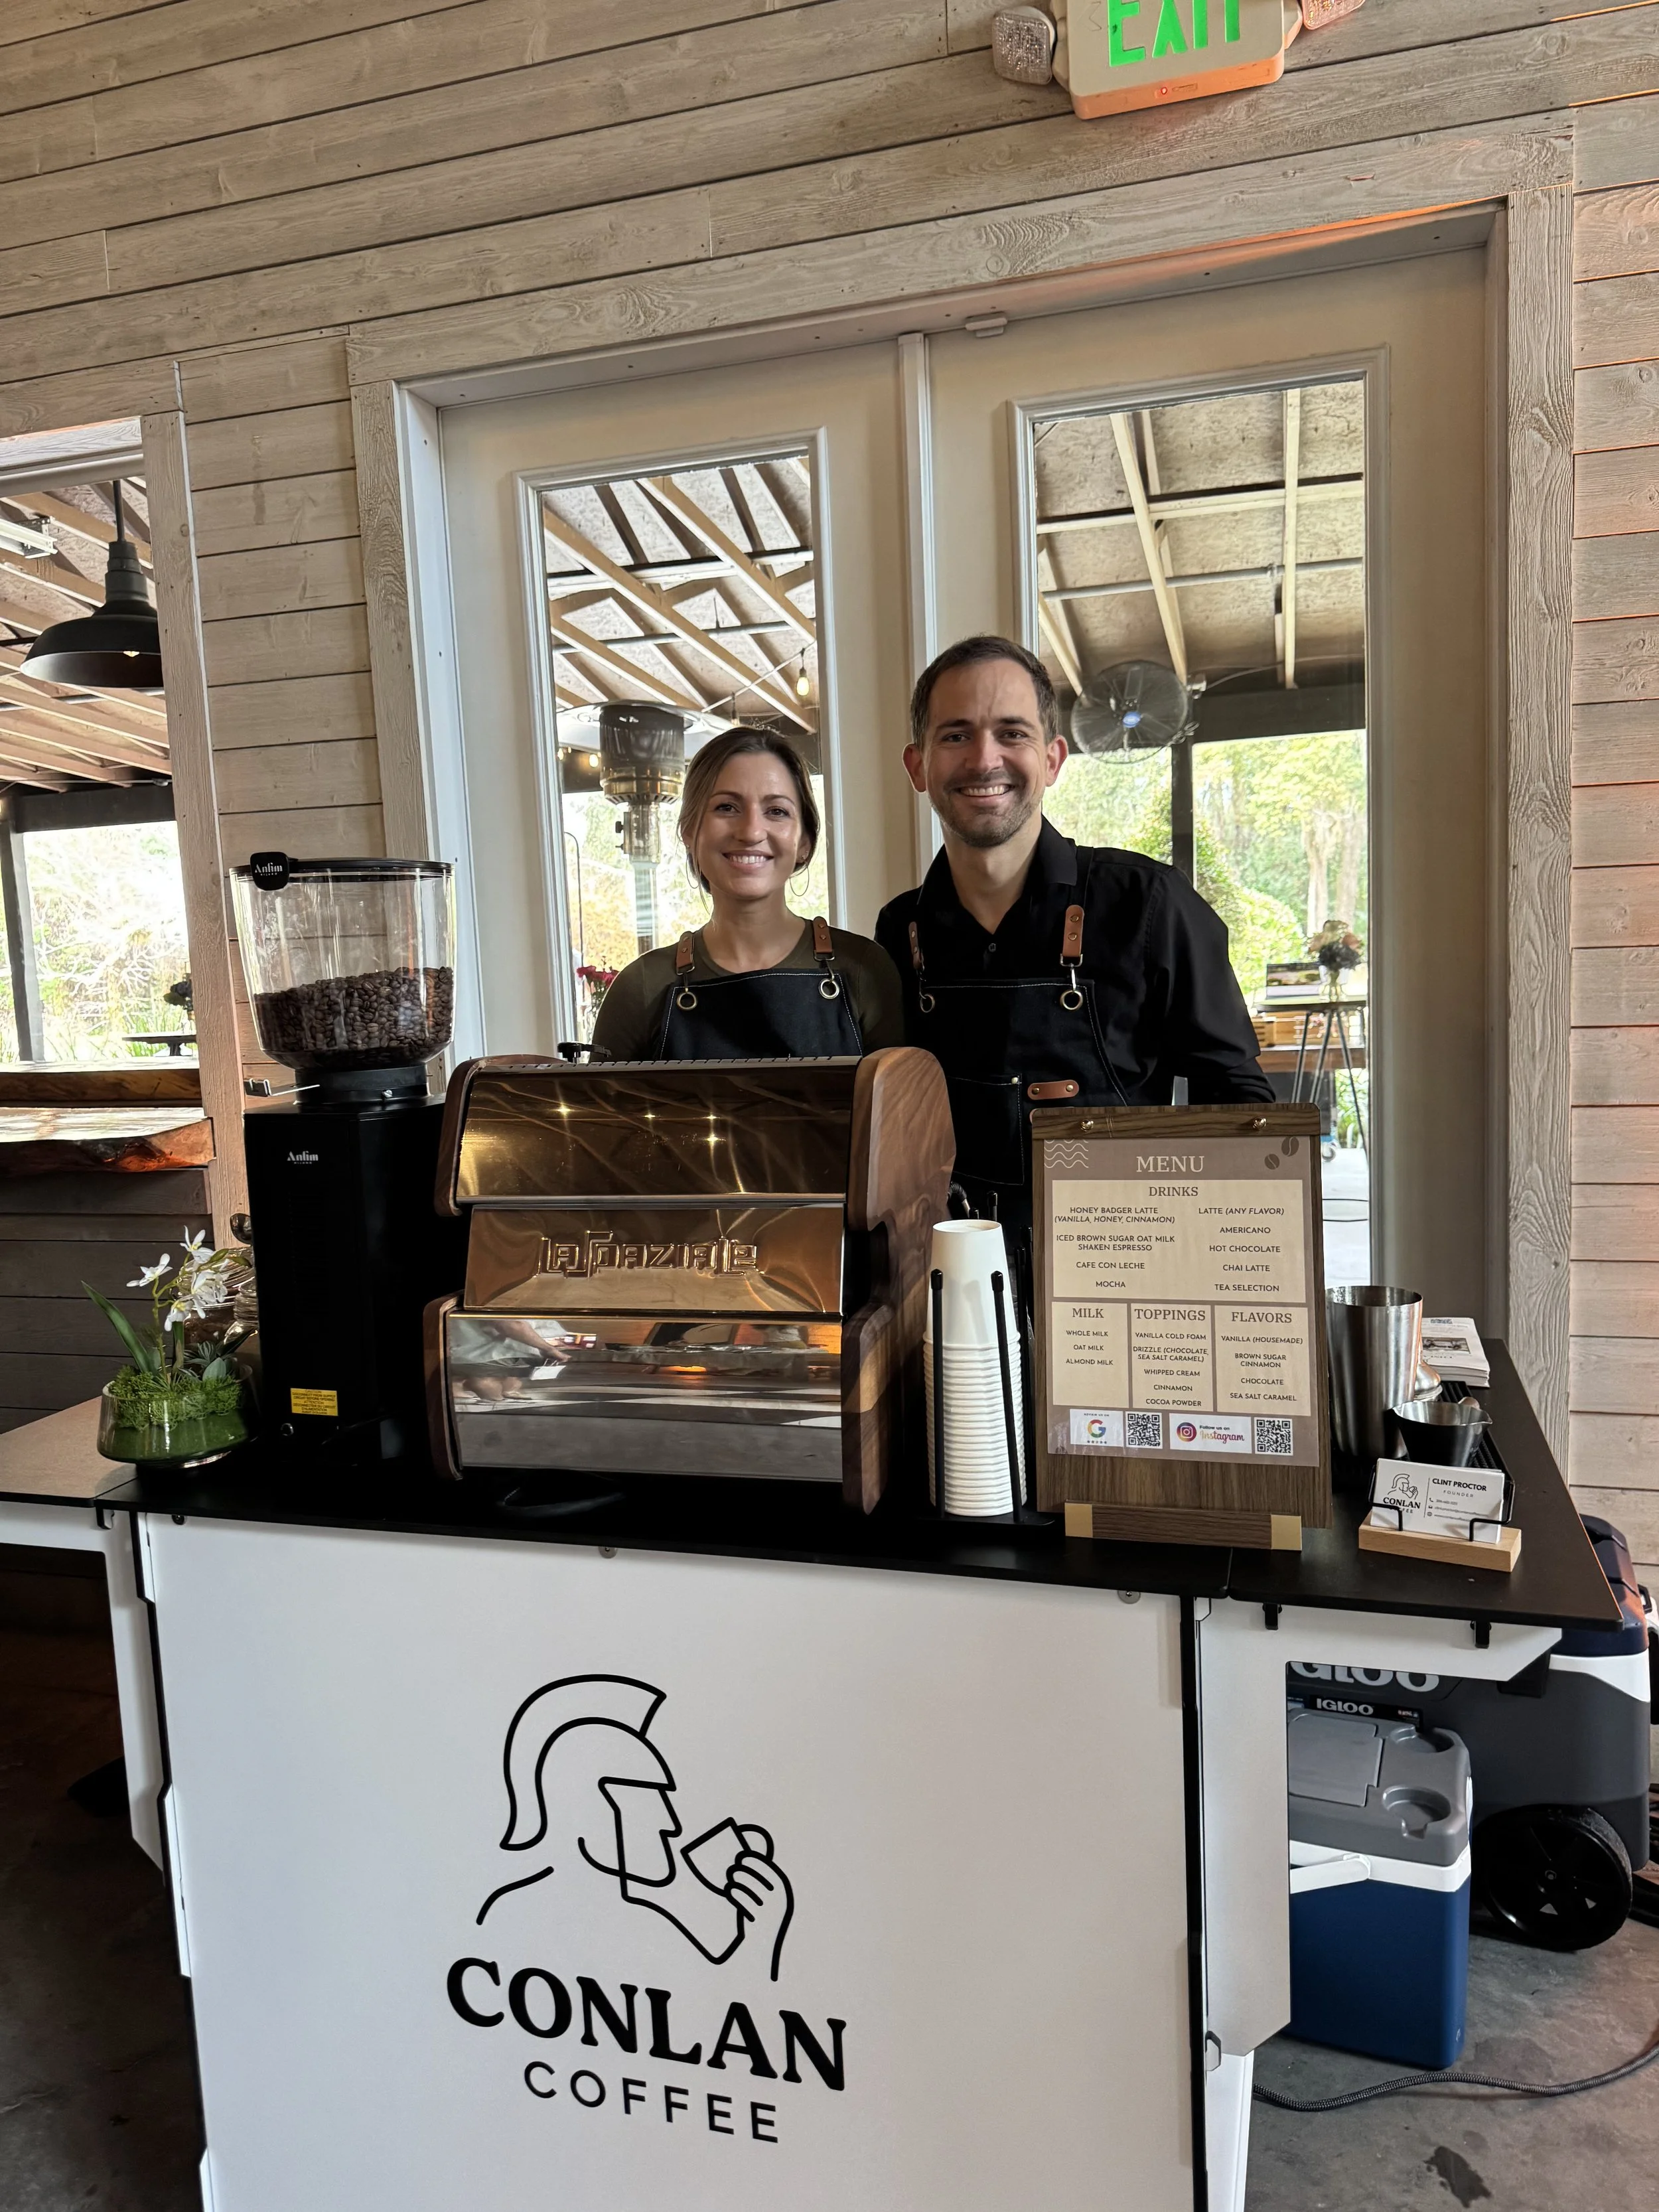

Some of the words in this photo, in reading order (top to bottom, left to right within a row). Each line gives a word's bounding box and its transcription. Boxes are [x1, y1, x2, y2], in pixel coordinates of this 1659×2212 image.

[255, 863, 283, 873] Anfim
[287, 1151, 318, 1161] Anfim
[1136, 1156, 1205, 1173] MENU
[1149, 1187, 1198, 1197] DRINKS
[1054, 1215, 1092, 1224] (VANILLA,
[1072, 1308, 1104, 1318] MILK
[1134, 1309, 1206, 1321] TOPPINGS
[1232, 1311, 1292, 1323] FLAVORS
[1200, 1430, 1245, 1443] Instagram
[1433, 1478, 1451, 1487] CLINT
[1453, 1481, 1486, 1491] PROCTOR
[1383, 1497, 1421, 1509] CONLAN
[1317, 1698, 1374, 1715] IGLOO
[447, 1957, 847, 2091] CONLAN
[524, 2061, 778, 2144] COFFEE
